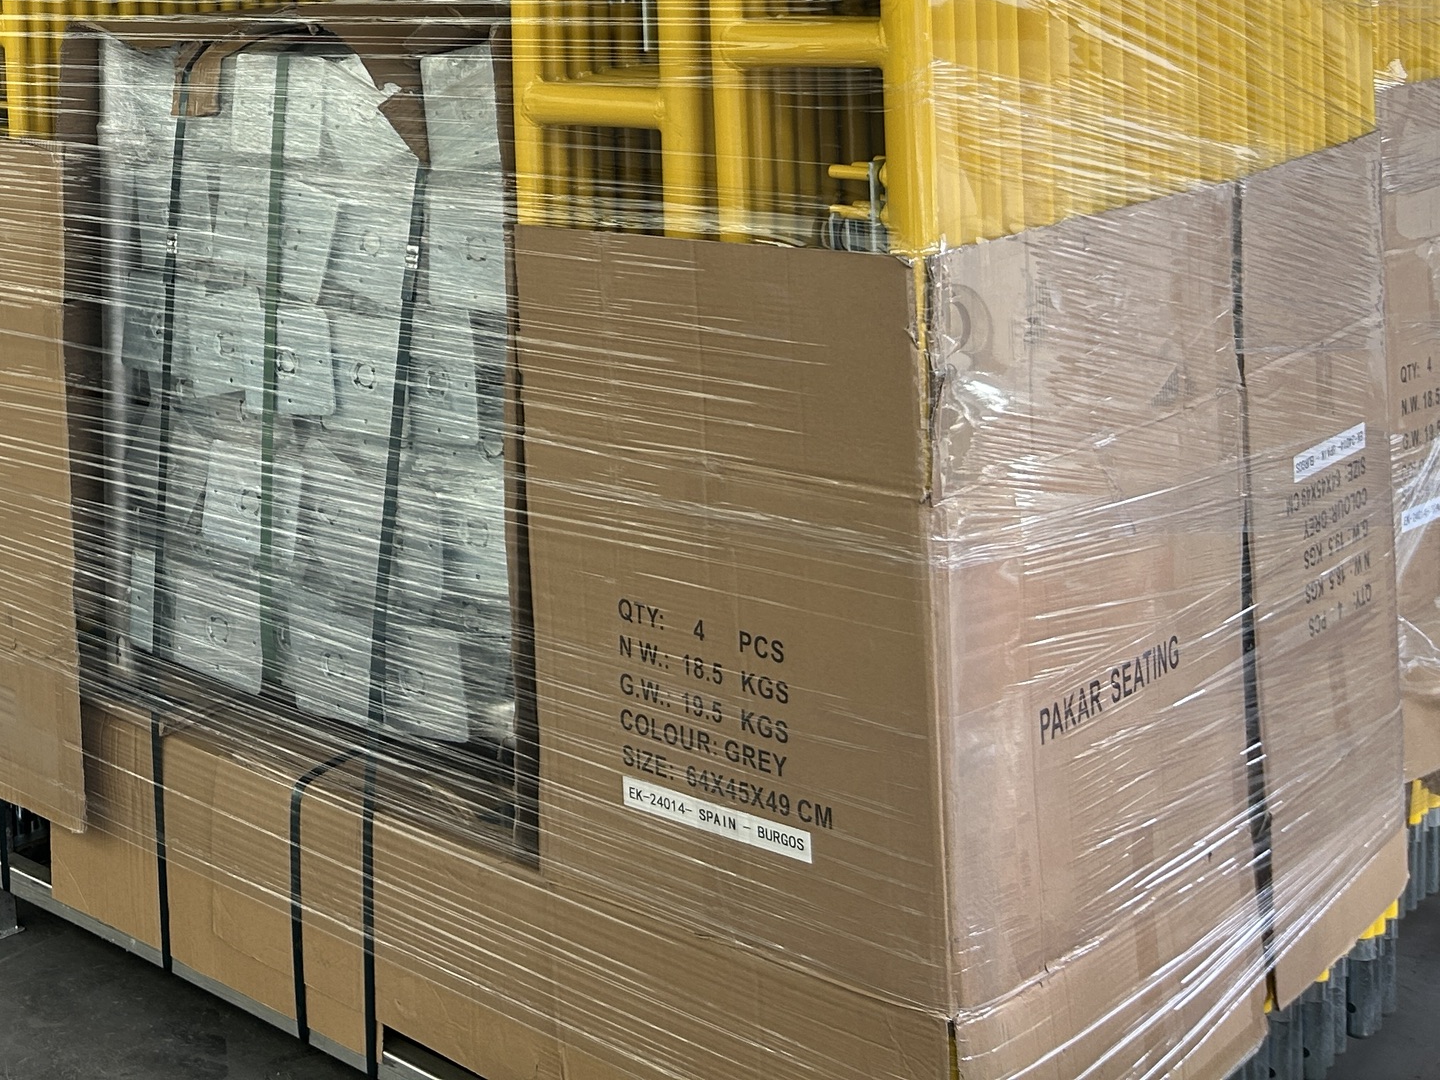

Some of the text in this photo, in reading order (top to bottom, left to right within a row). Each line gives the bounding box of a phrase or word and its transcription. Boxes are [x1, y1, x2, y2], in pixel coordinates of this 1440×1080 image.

[1401, 356, 1432, 383] QTY: 4
[1285, 492, 1300, 517] CM
[1328, 487, 1368, 524] COLOUR:
[1303, 510, 1328, 540] GREY
[1303, 542, 1323, 569] KGS
[1305, 579, 1324, 605] KGS
[1352, 583, 1372, 610] QTY:
[618, 598, 785, 664] QTY: 4 PCS
[1308, 610, 1327, 638] PCS
[683, 654, 724, 686] 18.5
[741, 670, 789, 704] KGS
[1039, 635, 1180, 746] PAKAR SEATING
[619, 673, 789, 744] G.W.: 19.5 KGS
[620, 708, 787, 777] COLOUR: GREY
[622, 744, 833, 830] SIZE: 64X45X49 CM
[629, 786, 693, 814] EK-24014-
[698, 808, 736, 831] SPAIN
[757, 825, 805, 851] BURGOS
